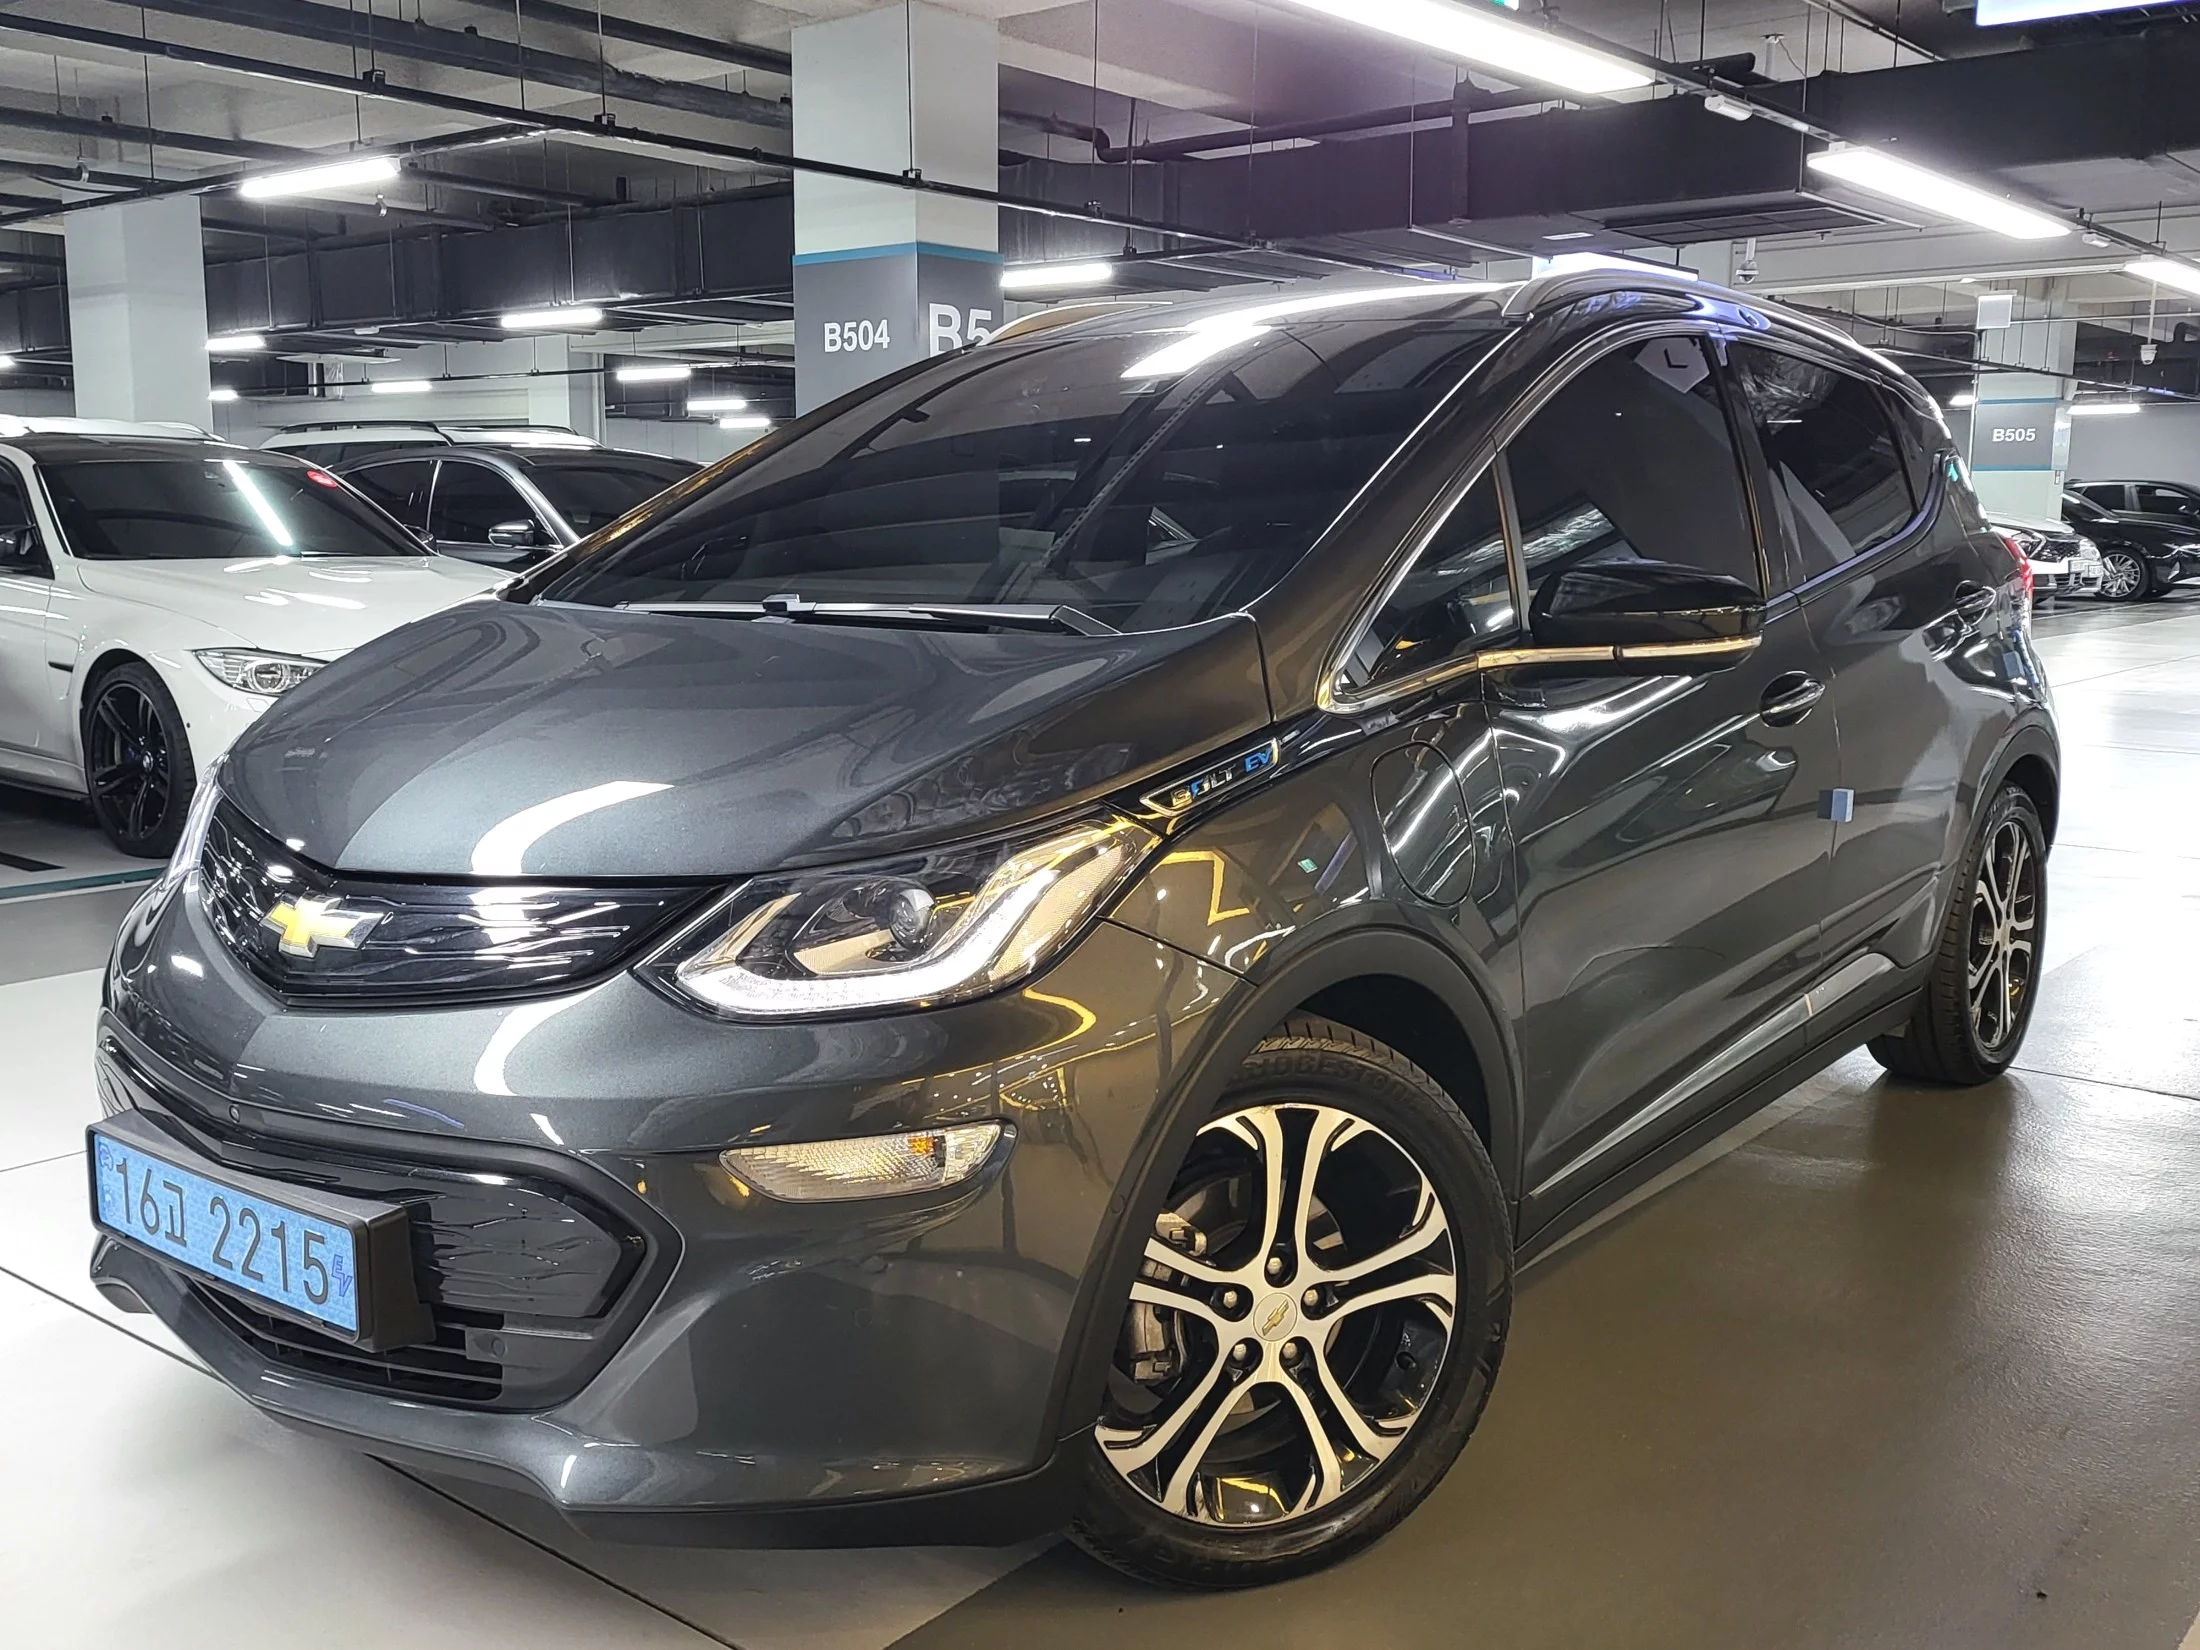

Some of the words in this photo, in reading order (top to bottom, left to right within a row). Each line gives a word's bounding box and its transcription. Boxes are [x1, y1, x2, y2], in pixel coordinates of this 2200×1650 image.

[823, 318, 891, 353] B504
[1992, 428, 2037, 442] B505
[1244, 747, 1273, 773] EV
[209, 1195, 329, 1305] 2215
[331, 1254, 353, 1298] EV
